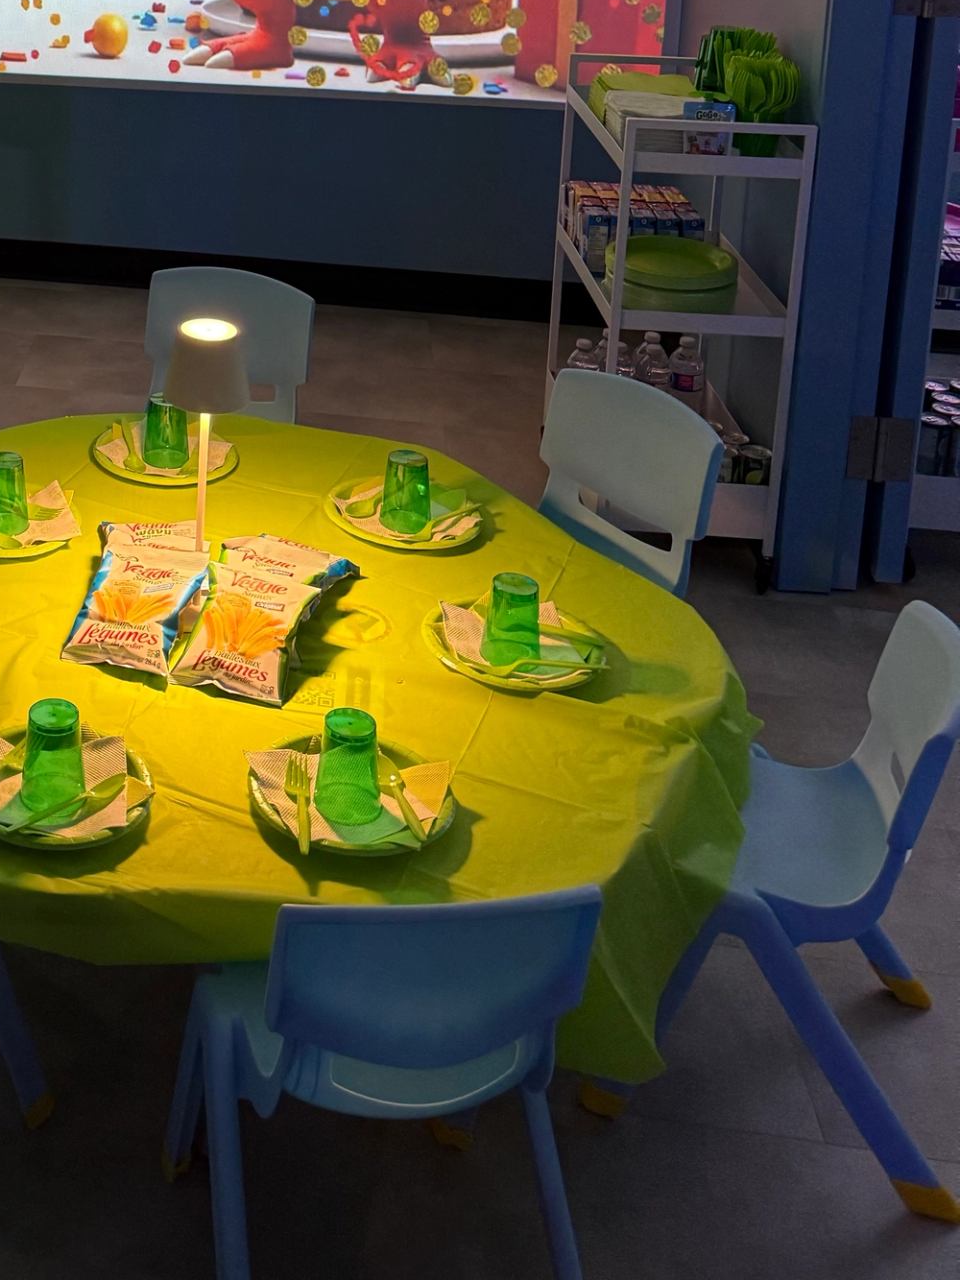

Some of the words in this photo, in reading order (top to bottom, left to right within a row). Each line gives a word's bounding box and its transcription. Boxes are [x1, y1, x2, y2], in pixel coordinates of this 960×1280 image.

[231, 570, 288, 596] Veggie
[78, 622, 159, 646] Légumes
[192, 649, 269, 682] Légumes
